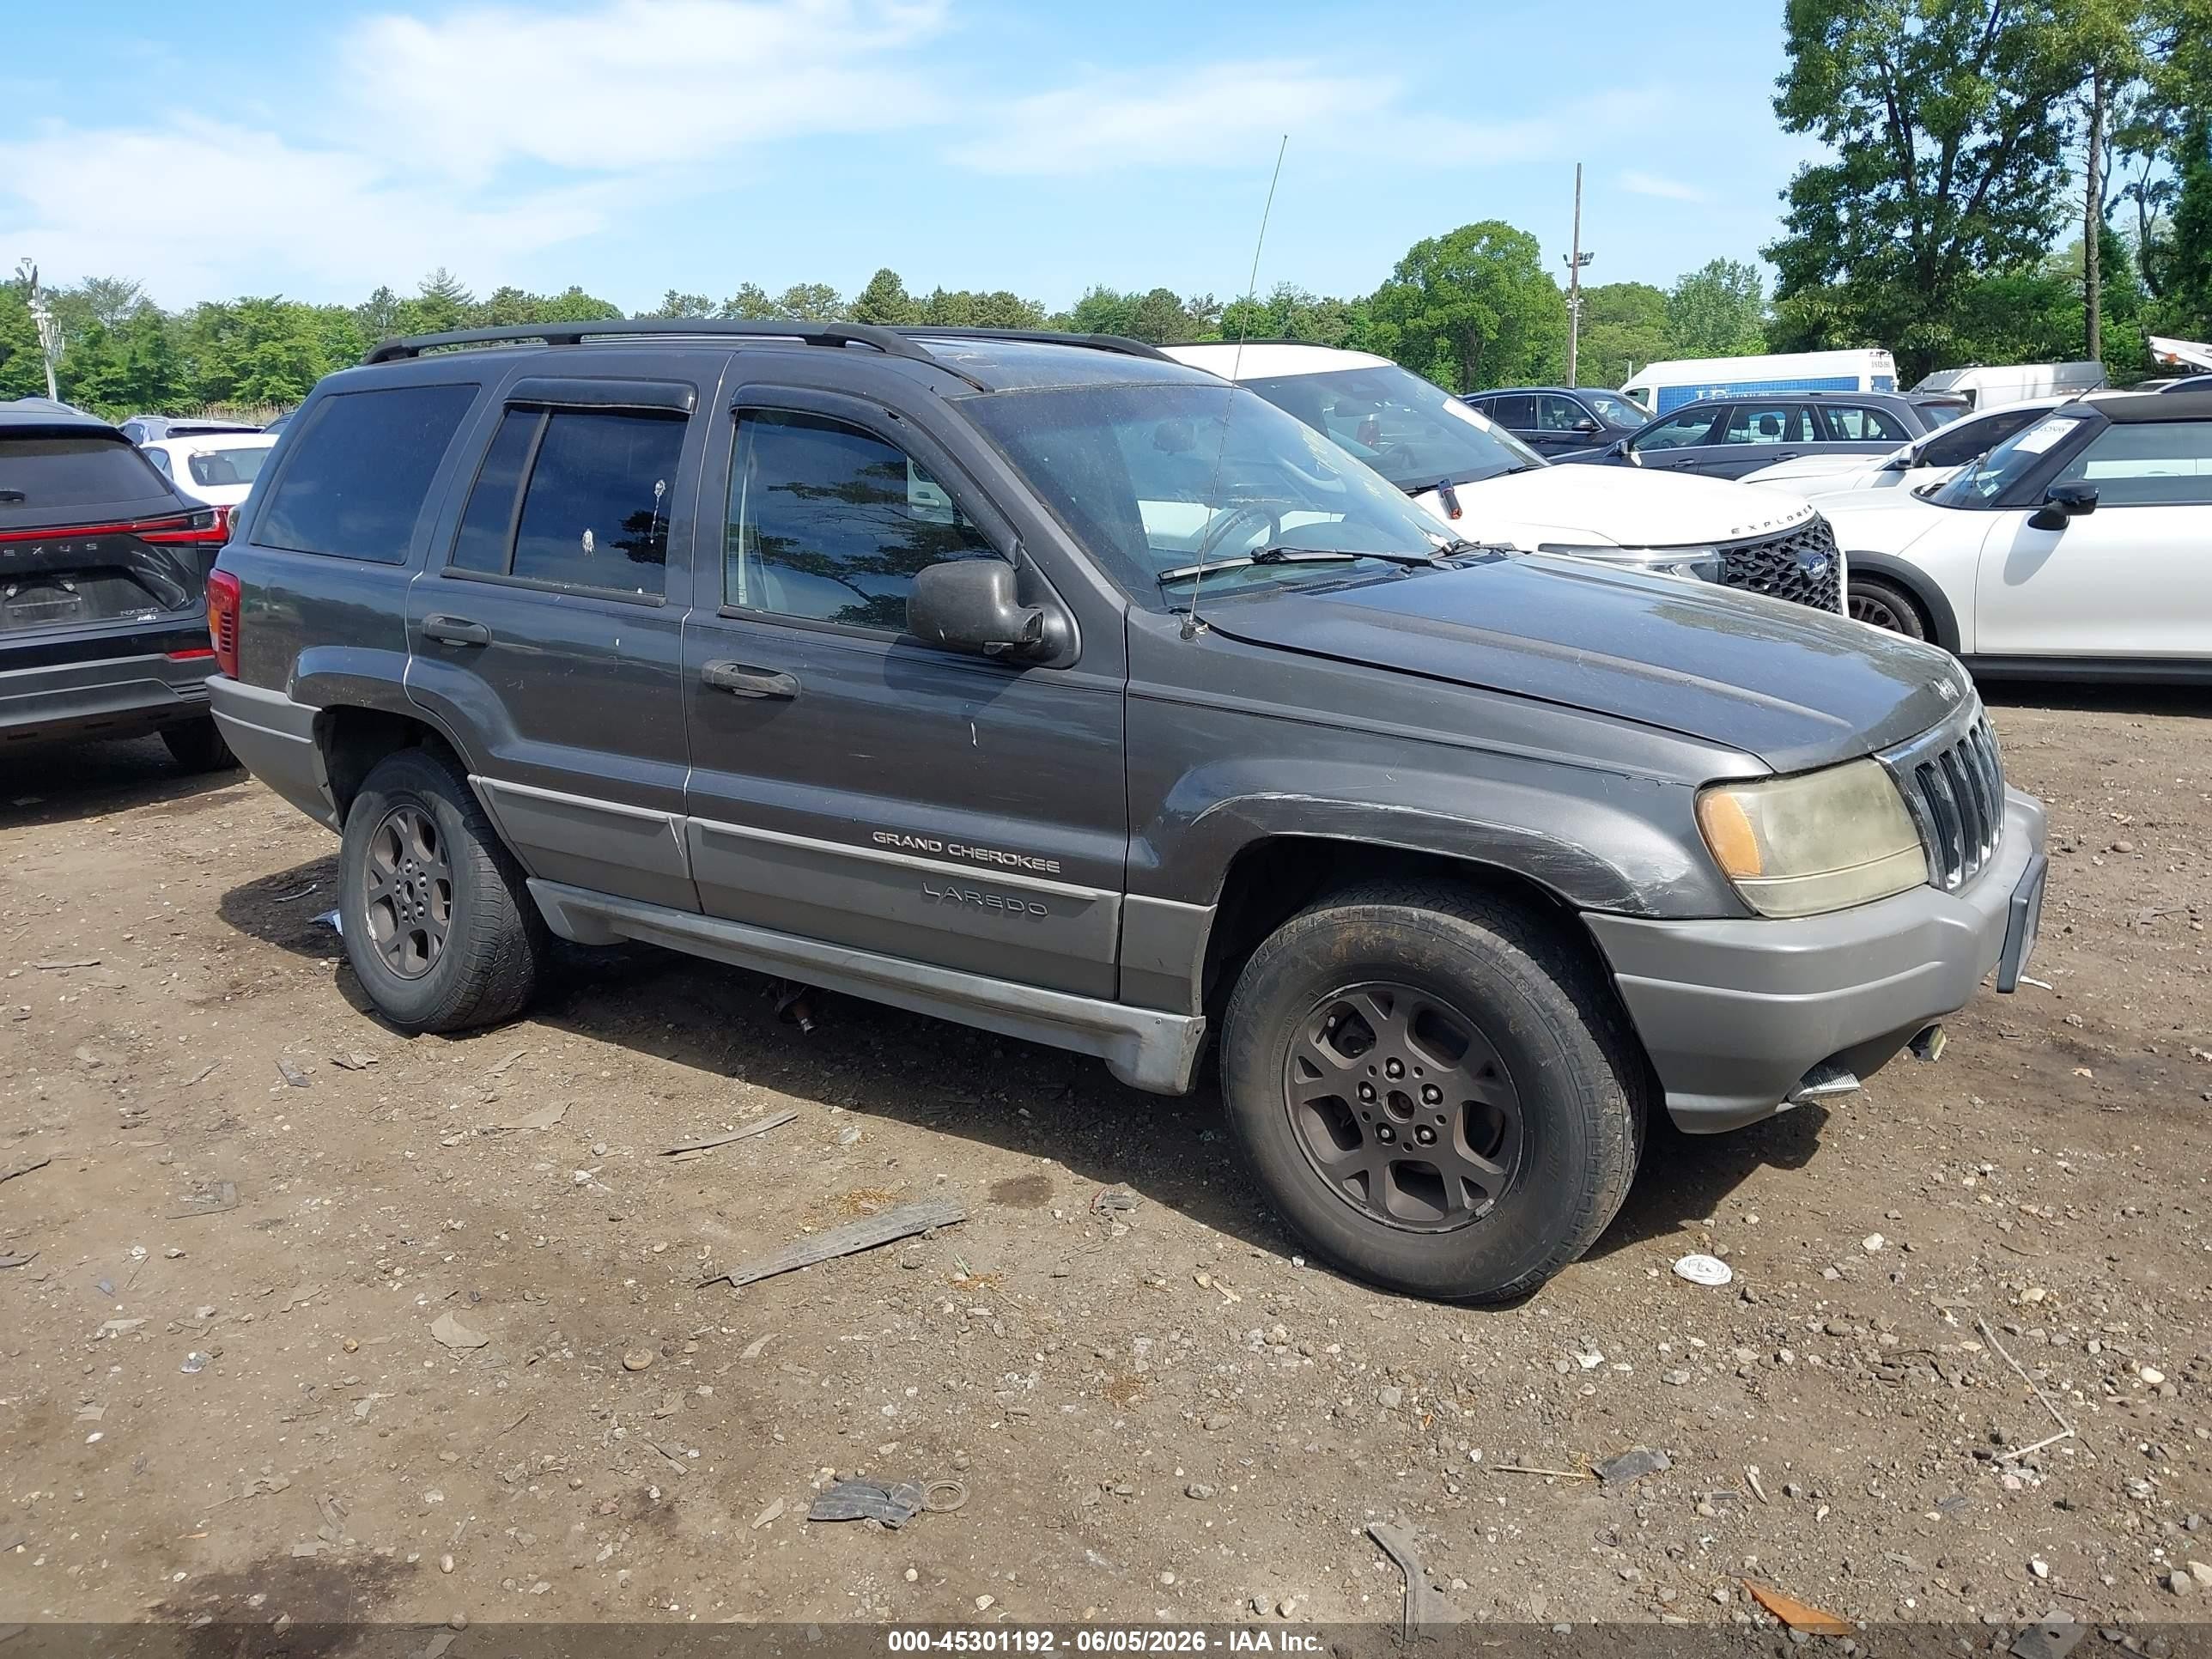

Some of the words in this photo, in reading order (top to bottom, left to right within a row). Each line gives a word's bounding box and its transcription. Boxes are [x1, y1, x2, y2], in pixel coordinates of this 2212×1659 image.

[3, 543, 97, 557] EXUS
[872, 831, 942, 853] GRAND
[947, 843, 1060, 874] CHEROKEE
[922, 881, 1048, 916] LAREDO
